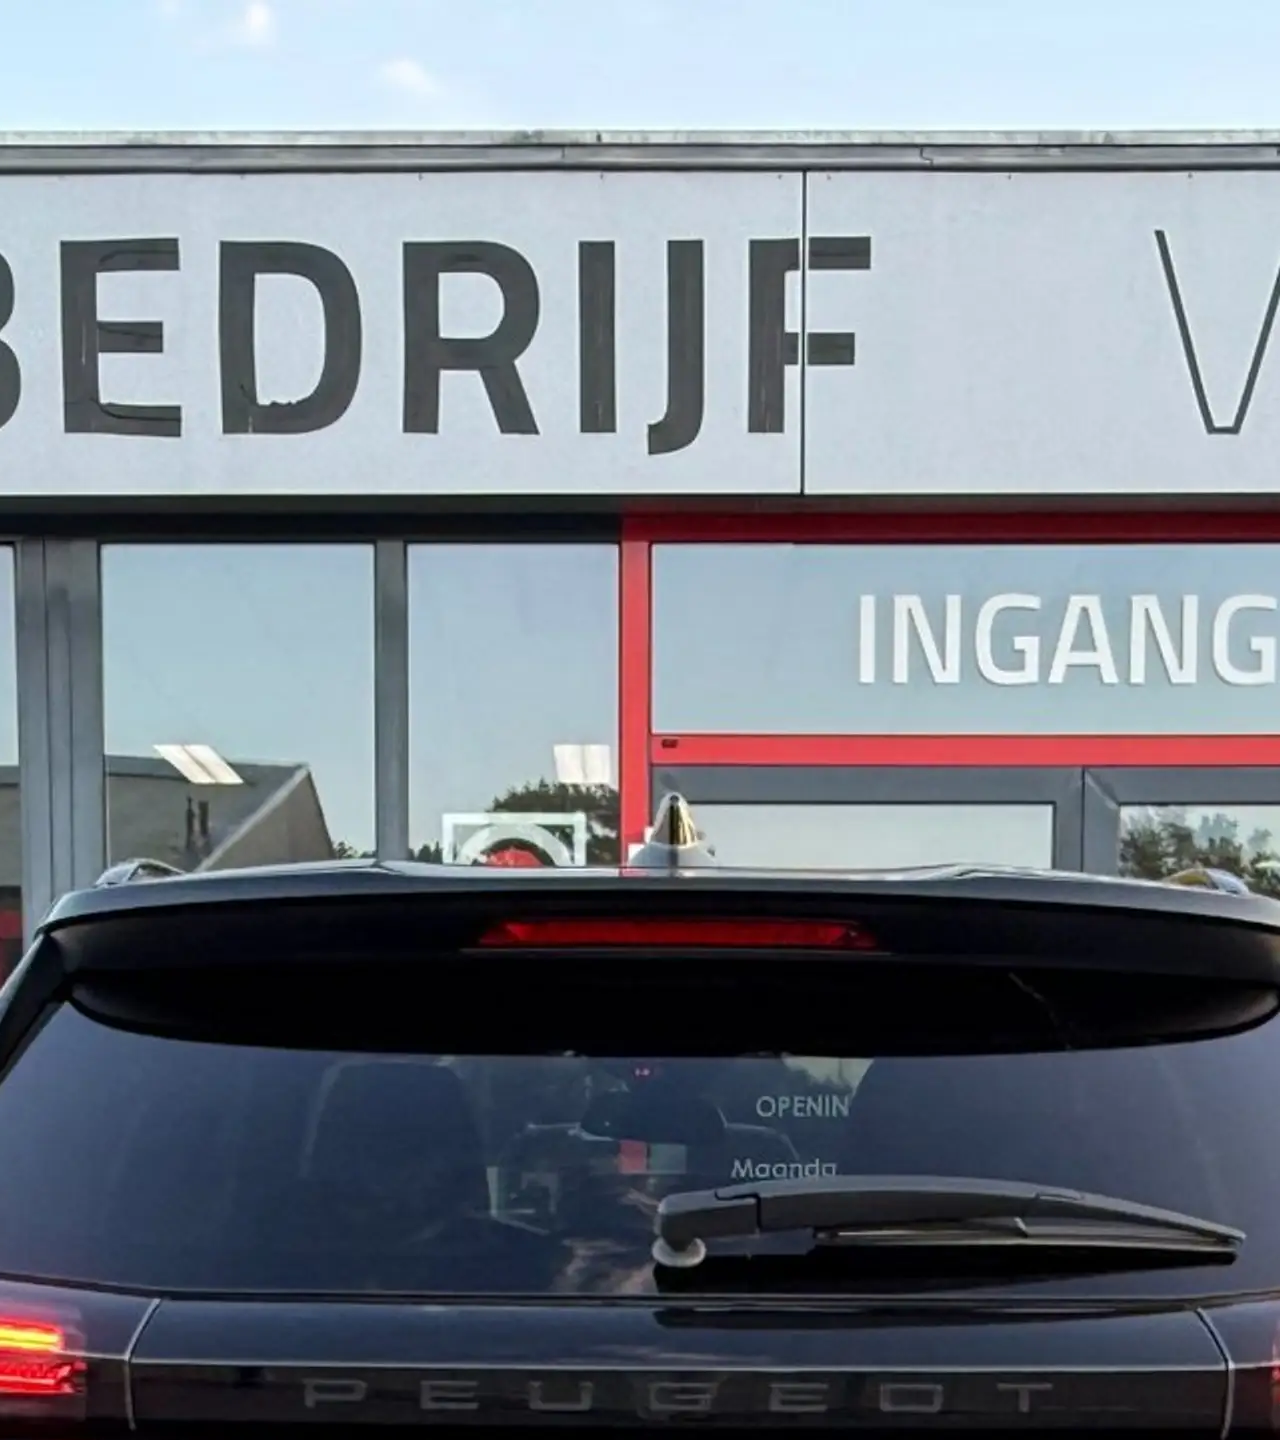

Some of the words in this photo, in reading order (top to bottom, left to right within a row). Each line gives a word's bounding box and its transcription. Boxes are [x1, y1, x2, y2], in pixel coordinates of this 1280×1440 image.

[858, 593, 1278, 685] INGANG
[755, 1093, 850, 1118] OPENIN
[302, 1376, 1053, 1415] PEUGEOT
